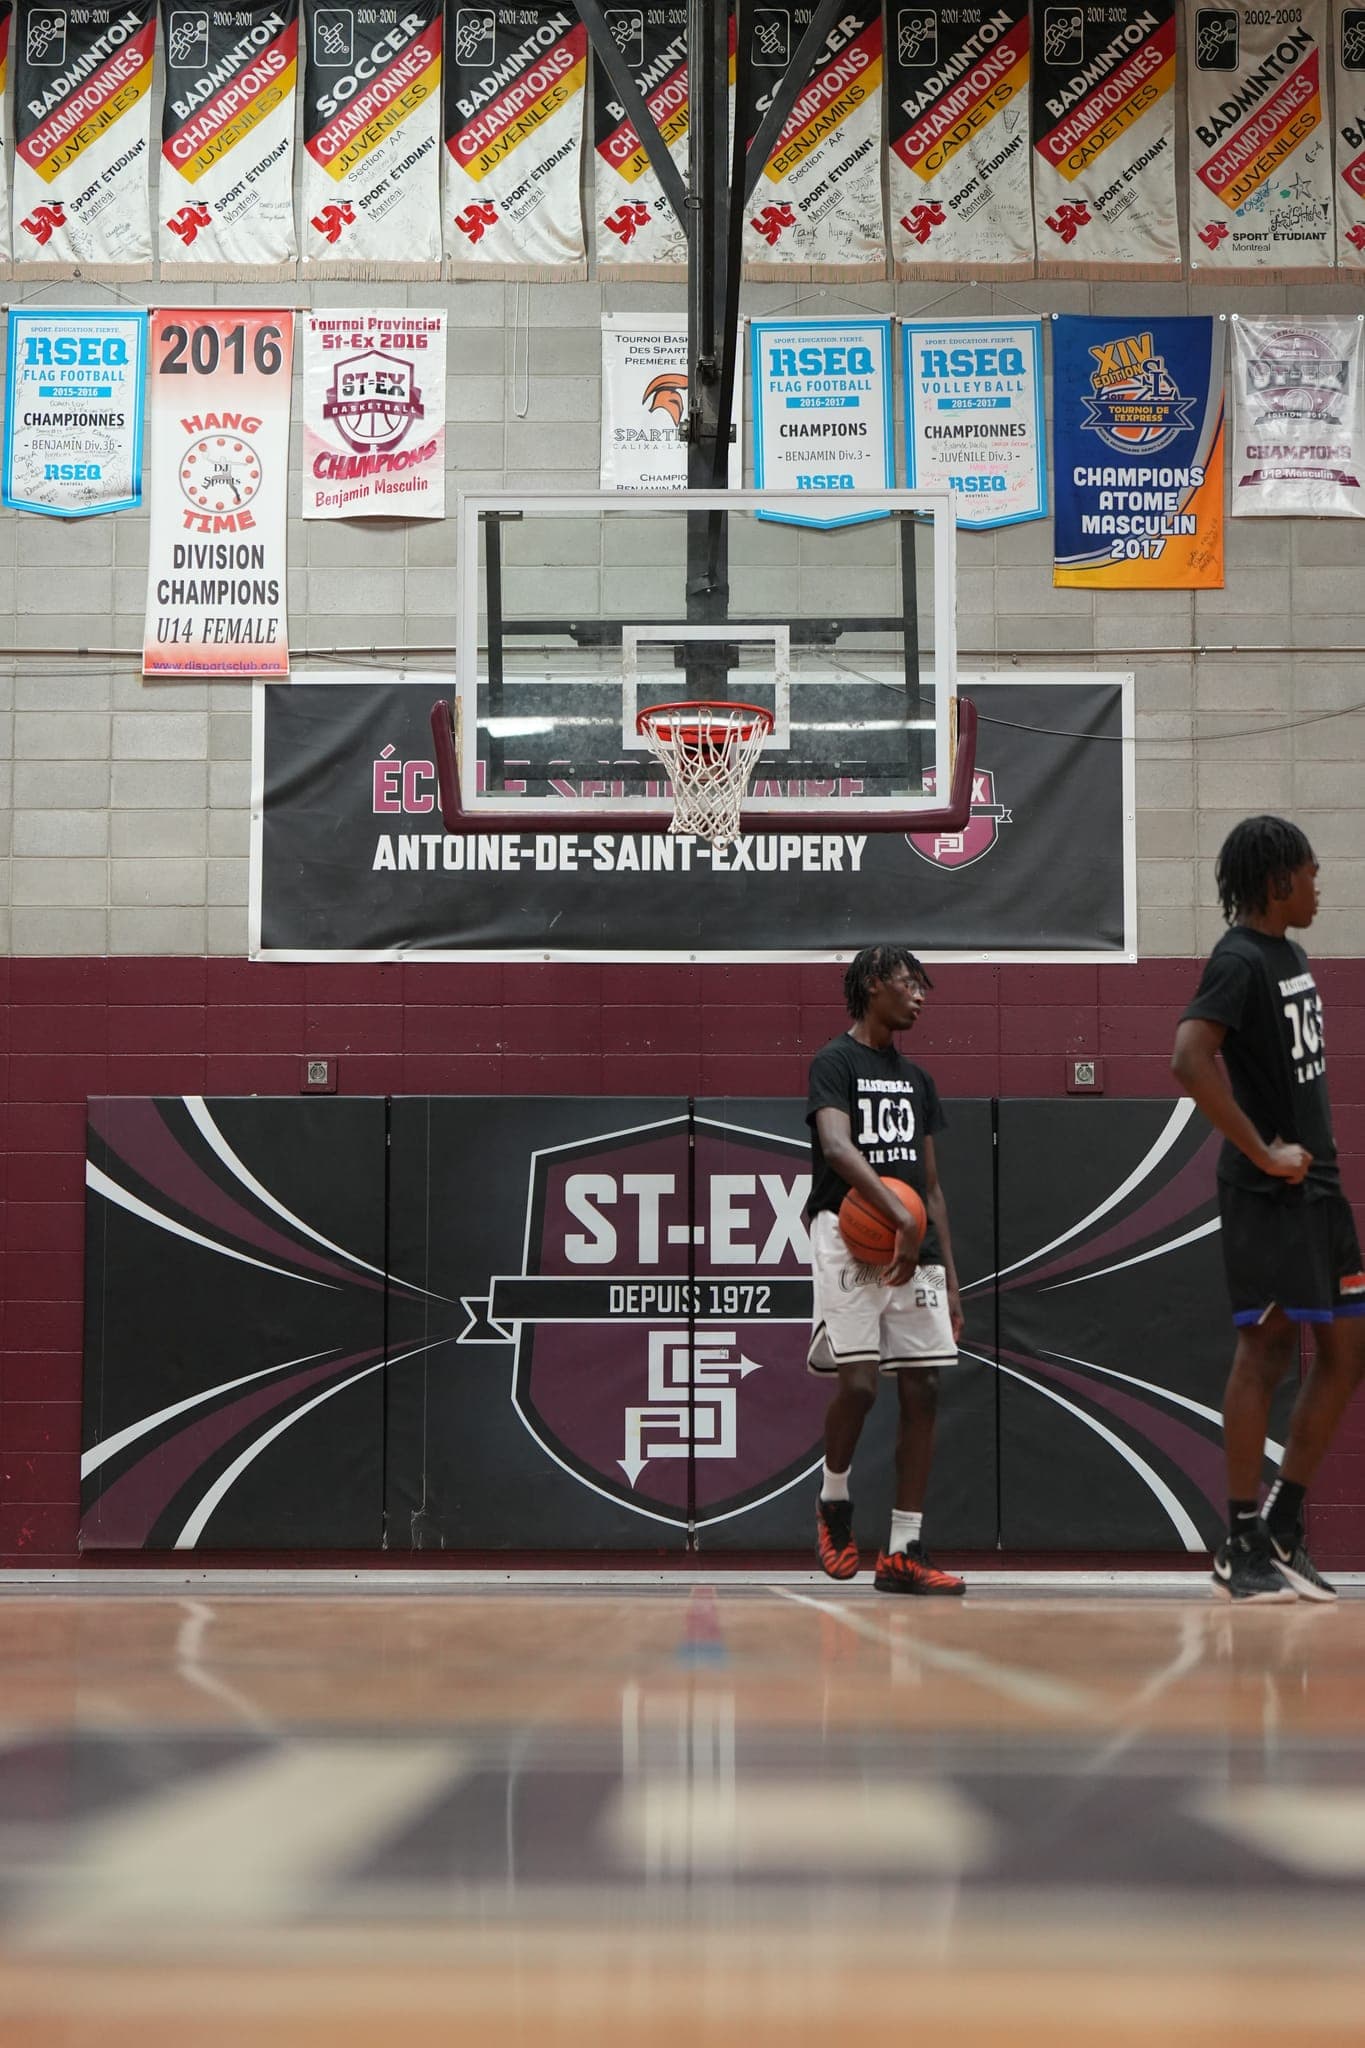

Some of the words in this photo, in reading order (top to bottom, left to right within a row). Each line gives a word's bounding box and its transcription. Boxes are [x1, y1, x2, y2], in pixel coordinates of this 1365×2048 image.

[70, 9, 110, 24] 2000-2001
[213, 10, 253, 26] 2000-2001
[357, 9, 397, 24] 2000-2001
[499, 10, 538, 25] 2001-2002
[941, 8, 981, 24] 2001-2002
[1087, 7, 1127, 23] 2001-2002
[1244, 9, 1303, 25] 2002-2003
[27, 10, 143, 121] BADMINTON
[170, 11, 287, 121] BADMINTON
[316, 12, 427, 118] SOCCER
[455, 12, 573, 119] BADMINTON
[901, 9, 1016, 120] BADMINTON
[1045, 10, 1160, 119] BADMINTON
[317, 44, 432, 157] CHAMPIONNES
[1195, 26, 1316, 149] BADMINTON
[28, 47, 144, 159] CHAMPIONNES
[171, 49, 287, 160] CHAMPIONS
[458, 47, 575, 157] CHAMPIONS
[904, 45, 1017, 157] CHAMPIONS
[1049, 46, 1163, 156] CHAMPIONNES
[50, 86, 141, 173] JUVÉNILES
[340, 84, 428, 173] JUVÉNILES
[773, 85, 866, 173] BENJAMINS
[925, 83, 1014, 171] CADETS
[1068, 84, 1159, 171] CADETTES
[1206, 75, 1314, 186] CHAMPIONNES
[348, 149, 386, 184] Section
[788, 151, 824, 185] Section
[1230, 112, 1317, 203] JUVÉNILES
[69, 180, 102, 213] SPORT
[101, 139, 147, 183] ÉTUDIANT
[213, 180, 246, 213] SPORT
[246, 139, 290, 183] ÉTUDIANT
[358, 178, 391, 210] SPORT
[390, 136, 436, 180] ÉTUDIANT
[500, 179, 532, 211] SPORT
[531, 137, 577, 181] ÉTUDIANT
[798, 180, 830, 212] SPORT
[830, 138, 874, 183] ÉTUDIANT
[948, 178, 980, 211] SPORT
[979, 135, 1024, 180] ÉTUDIANT
[1093, 180, 1124, 212] SPORT
[1122, 136, 1168, 182] ÉTUDIANT
[1232, 232, 1268, 241] SPORT
[1273, 230, 1327, 241] ÉTUDIANT
[309, 316, 364, 331] Tournoi
[367, 316, 441, 331] Provincial
[25, 337, 129, 367] RSEQ
[158, 324, 283, 376] 2016
[322, 333, 377, 350] St-Ex
[379, 333, 429, 350] 2016
[615, 335, 661, 343] TOURNOI
[630, 346, 651, 354] DES
[653, 346, 689, 354] SPART
[769, 346, 876, 377] RSEQ
[921, 348, 1026, 378] RSEQ
[1091, 333, 1153, 375] XIV
[23, 370, 56, 381] FLAG
[61, 370, 125, 382] FOOTBALL
[342, 371, 406, 397] ST-EX
[770, 380, 802, 393] FLAG
[806, 379, 872, 392] FOOTBALL
[922, 380, 1024, 394] VOLLEYBALL
[1093, 363, 1143, 390] ÉDITION
[53, 388, 98, 397] 2015-2016
[800, 397, 845, 408] 2016-2017
[951, 399, 997, 409] 2016-2017
[24, 412, 125, 427] CHAMPIONNES
[331, 402, 417, 416] BASKETBALL
[1108, 406, 1153, 414] TOURNOI
[1156, 406, 1169, 414] DE
[1114, 414, 1163, 422] L'EXPRESS
[180, 412, 263, 435] HANG
[780, 423, 867, 438] CHAMPIONS
[924, 423, 1026, 439] CHAMPIONNES
[32, 439, 82, 451] BENJAMIN
[785, 449, 836, 462] BENJAMIN
[838, 449, 863, 462] Div.3
[938, 449, 986, 463] JUVÉNILE
[988, 450, 1013, 462] Div.3
[1246, 444, 1352, 460] CHAMPIONS
[44, 464, 102, 481] RSEQ
[213, 463, 230, 473] DJ
[313, 440, 438, 481] CHAMPIONS
[640, 473, 689, 482] CHAMPIO
[948, 475, 1007, 493] RSEQ
[1073, 466, 1205, 488] CHAMPIONS
[315, 485, 370, 508] Benjamin
[374, 477, 428, 493] Masculin
[1098, 491, 1178, 511] ATOME
[182, 509, 257, 535] TIME
[1081, 515, 1197, 535] MASCULIN
[173, 544, 265, 570] DIVISION
[1110, 539, 1167, 559] 2017
[156, 580, 280, 605] CHAMPIONS
[157, 617, 193, 644] U14
[202, 617, 279, 644] FEMALE
[858, 1097, 915, 1144] 100
[564, 1174, 813, 1265] ST-EX
[609, 1285, 700, 1314] DEPUIS
[709, 1285, 771, 1314] 1972
[915, 1289, 938, 1307] 23
